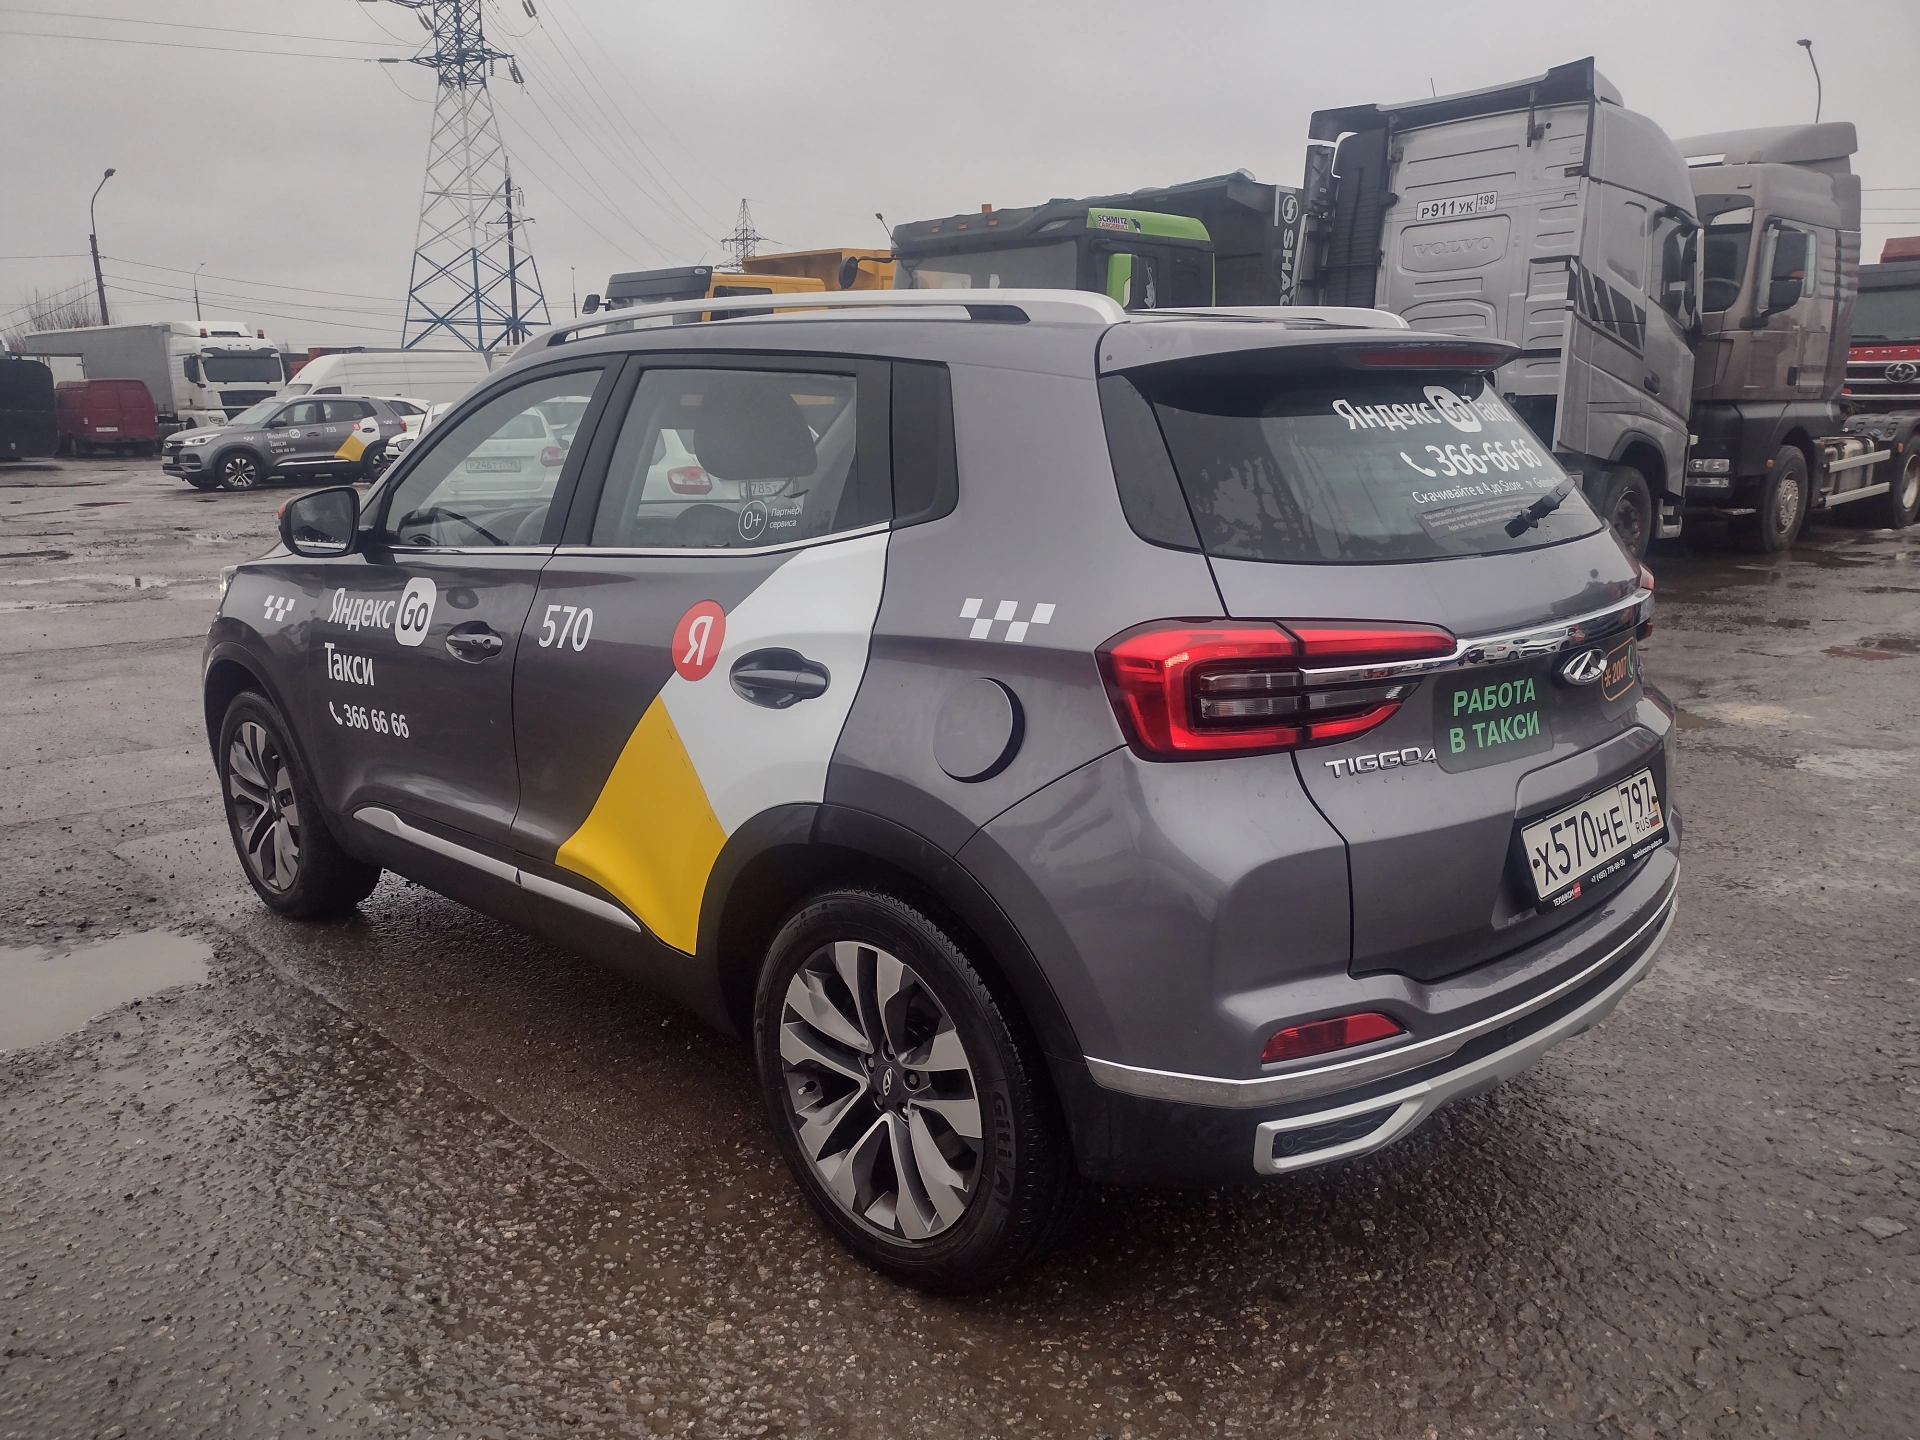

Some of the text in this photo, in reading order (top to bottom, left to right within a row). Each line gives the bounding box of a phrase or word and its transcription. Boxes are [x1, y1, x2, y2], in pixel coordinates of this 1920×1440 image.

[1097, 214, 1128, 225] SCHMITZ
[1478, 194, 1496, 206] 198
[1412, 236, 1495, 258] VOLVO
[1332, 398, 1442, 432] Яндекс
[1431, 393, 1475, 423] Go
[1424, 438, 1542, 477] 366-66-66
[1412, 485, 1476, 504] Скачивайте
[1475, 486, 1485, 495] в
[1500, 479, 1524, 492] Store
[744, 511, 762, 530] 0+
[769, 519, 797, 530] сервиса
[327, 587, 430, 633] Яндекс Go
[538, 604, 594, 652] 570
[682, 615, 714, 666] Я
[324, 641, 375, 686] Такси
[1452, 677, 1537, 717] РАБОТА
[343, 703, 410, 739] 366 66 66
[1449, 710, 1541, 754] В ТАКСИ
[1620, 776, 1652, 824] 797
[1635, 819, 1651, 835] RUS
